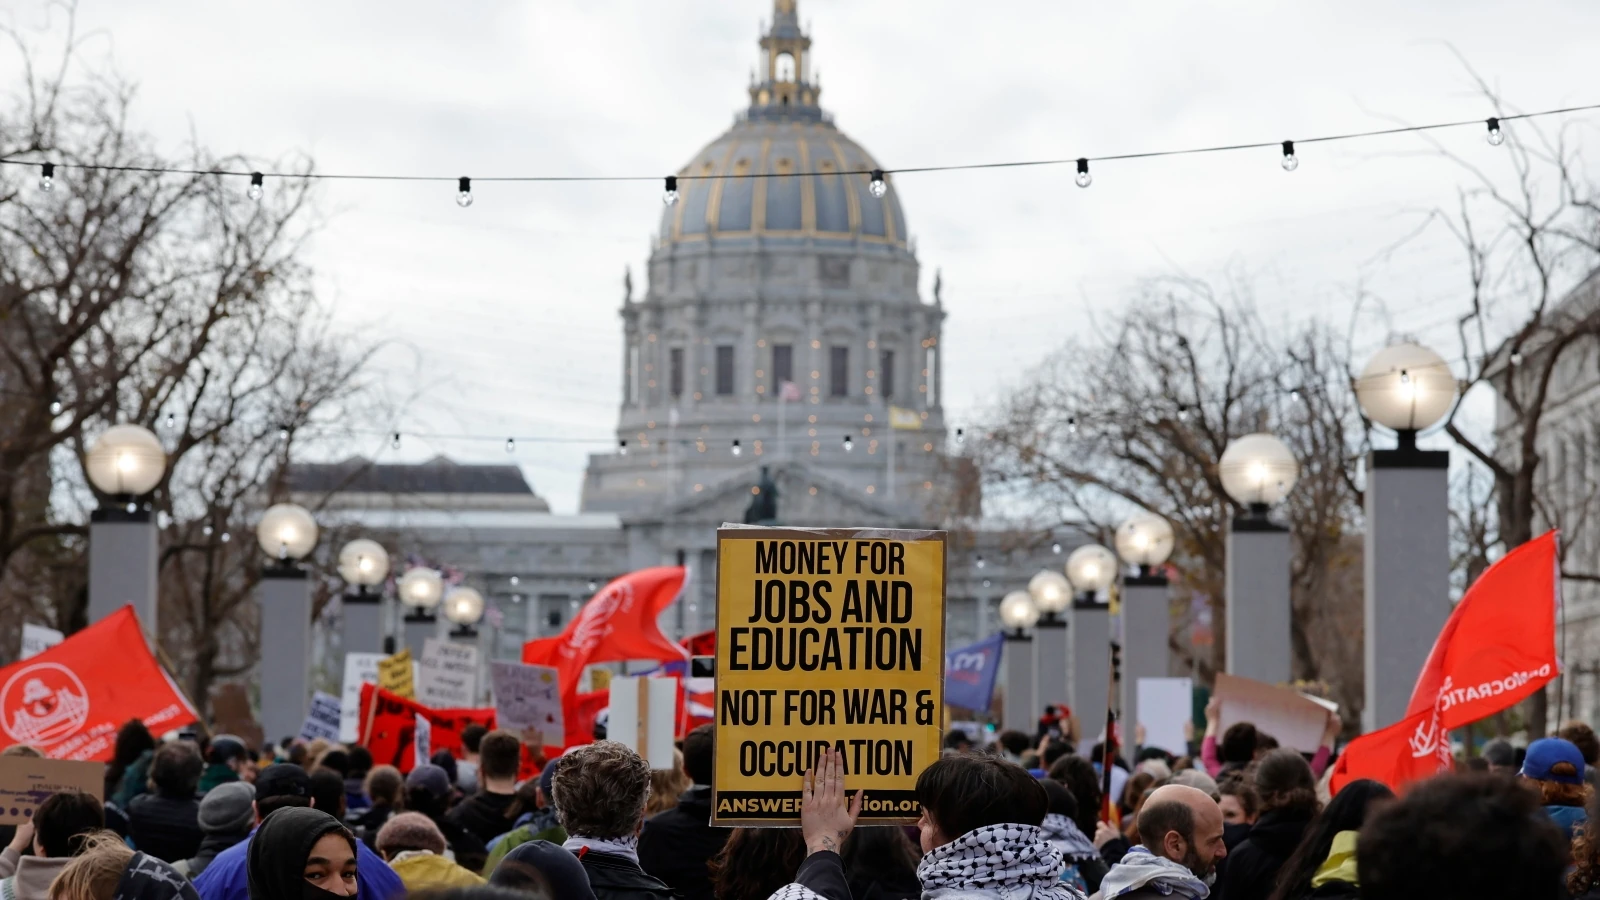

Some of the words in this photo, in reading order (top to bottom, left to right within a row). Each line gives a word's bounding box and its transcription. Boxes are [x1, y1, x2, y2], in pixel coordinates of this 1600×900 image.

[755, 541, 848, 575] MONEY
[855, 541, 905, 575] FOR
[748, 580, 832, 624] JOBS
[841, 580, 912, 624] AND
[729, 627, 922, 671] EDUCATION
[721, 689, 777, 726] NOT
[784, 689, 836, 726] FOR
[843, 689, 907, 725] WAR
[915, 690, 935, 726] &
[739, 739, 913, 777] OCCUPATION
